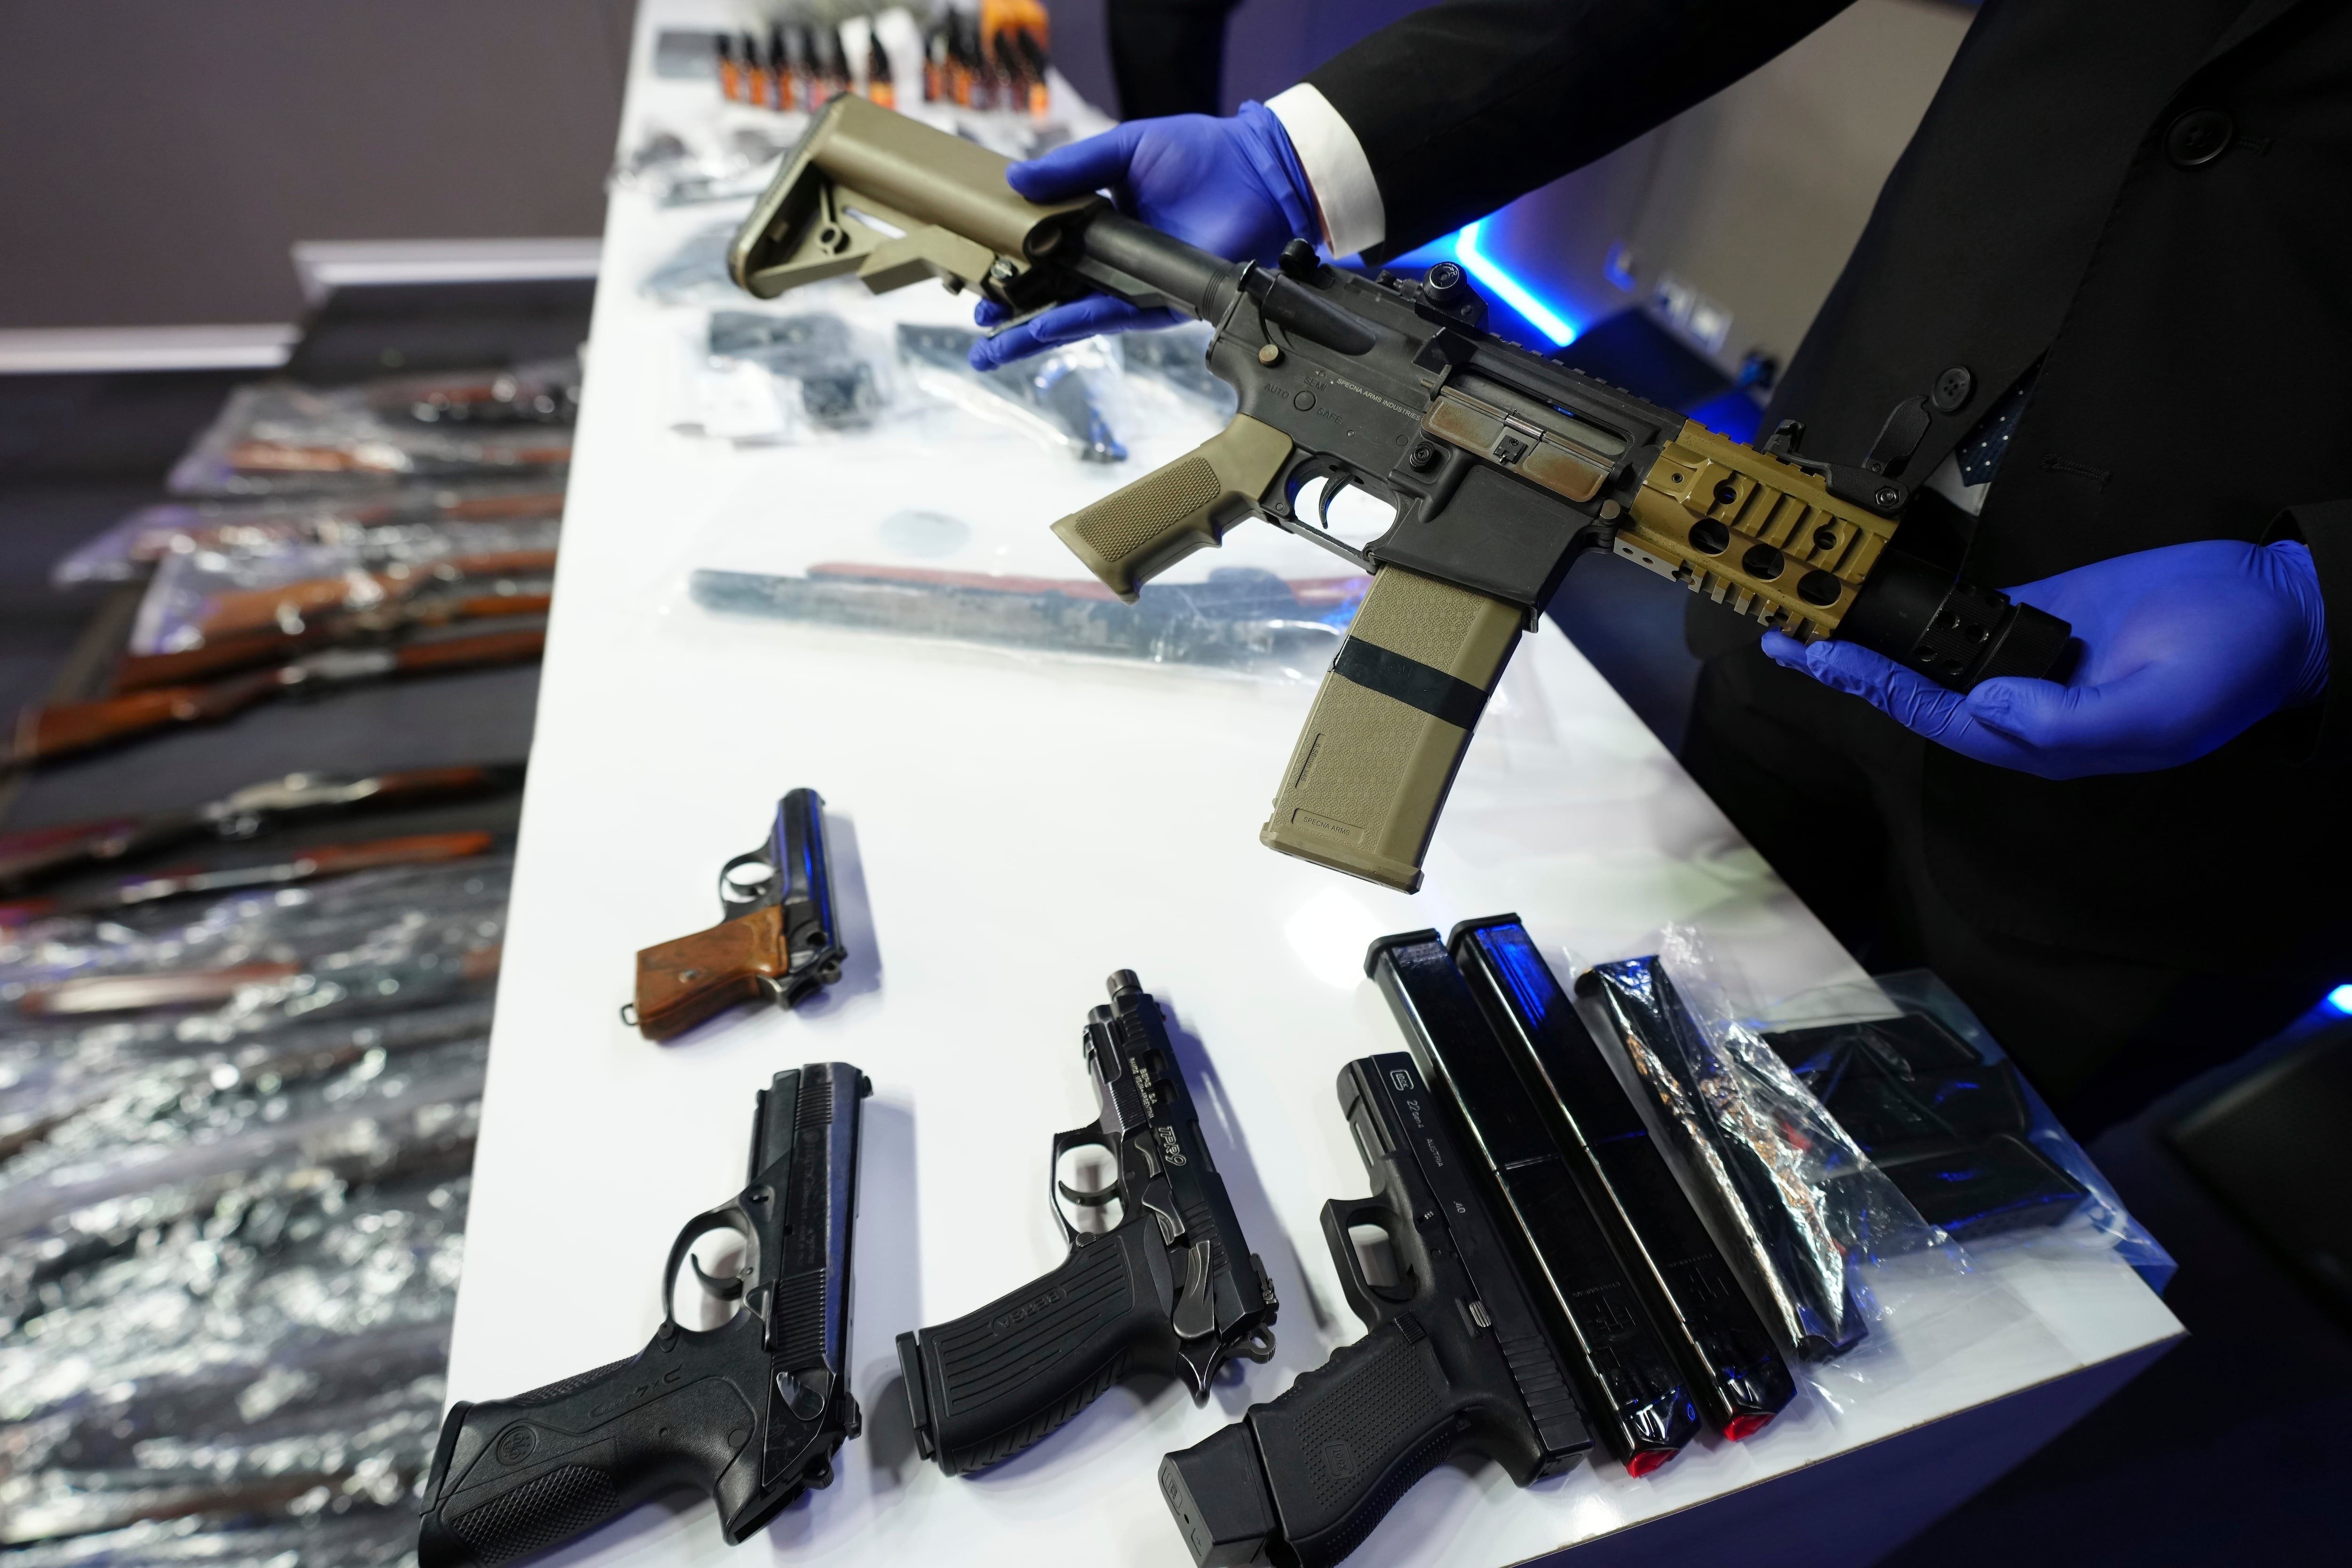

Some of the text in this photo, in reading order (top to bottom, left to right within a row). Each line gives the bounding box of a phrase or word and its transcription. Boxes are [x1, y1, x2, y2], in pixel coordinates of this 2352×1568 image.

[1265, 383, 1290, 398] AUTO
[1304, 376, 1327, 391] SEMI
[1337, 378, 1421, 421] SPECNA ARMS INDUSTRIES
[1318, 407, 1343, 424] SAFE
[1303, 816, 1350, 836] SPECNA ARMS
[1390, 1069, 1414, 1091] GLOCK
[1426, 1138, 1443, 1167] AUSTRIA
[1159, 1125, 1186, 1166] TPR9
[996, 1292, 1061, 1329] BERSA
[1325, 1444, 1354, 1476] GLOCK
